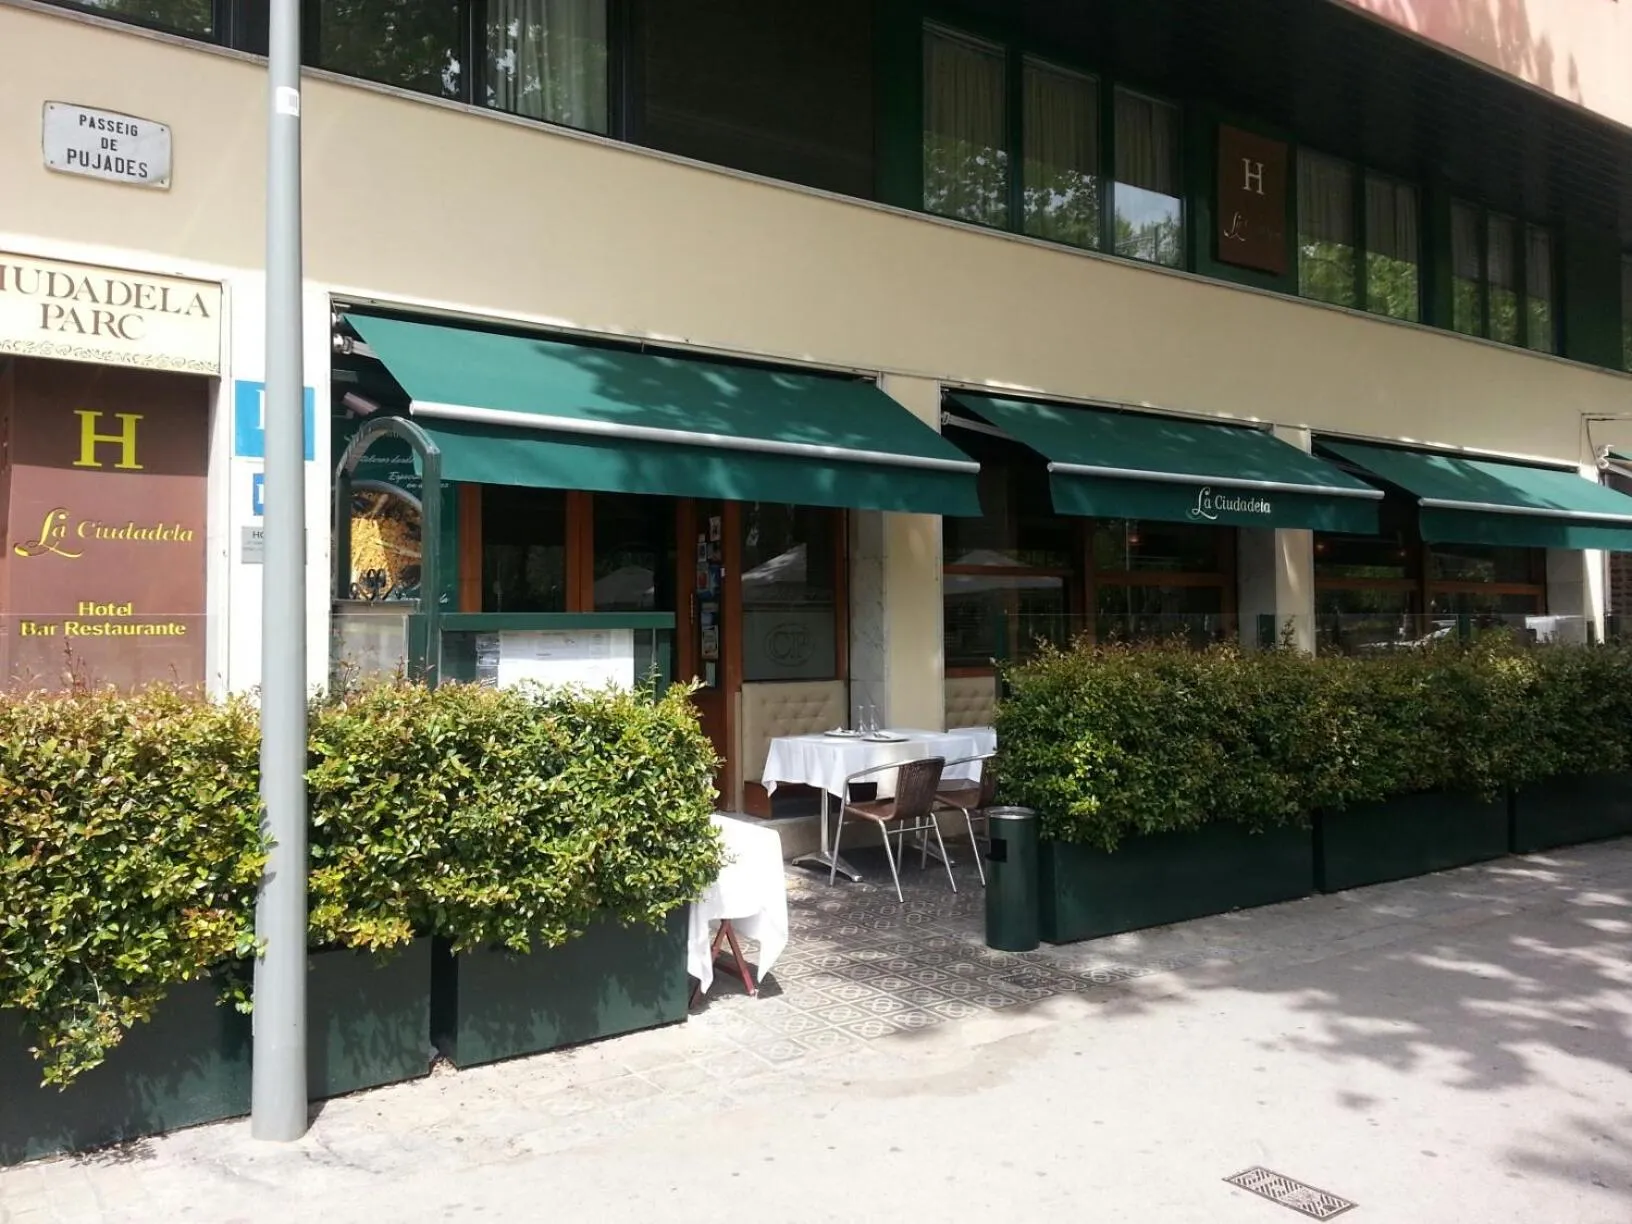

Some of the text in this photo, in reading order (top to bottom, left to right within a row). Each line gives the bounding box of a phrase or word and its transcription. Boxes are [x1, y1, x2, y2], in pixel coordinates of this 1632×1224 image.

[79, 114, 139, 136] PASSEIG
[100, 137, 118, 152] DE
[66, 148, 148, 179] PUJADES
[1241, 157, 1265, 196] H
[0, 263, 211, 318] IUDADELA
[39, 302, 145, 341] PARC
[72, 409, 144, 470] H
[1186, 486, 1271, 520] La Ciudadela
[13, 507, 193, 558] La Ciudadela
[78, 602, 133, 617] Hotel
[20, 620, 186, 637] Bar Restaurante
